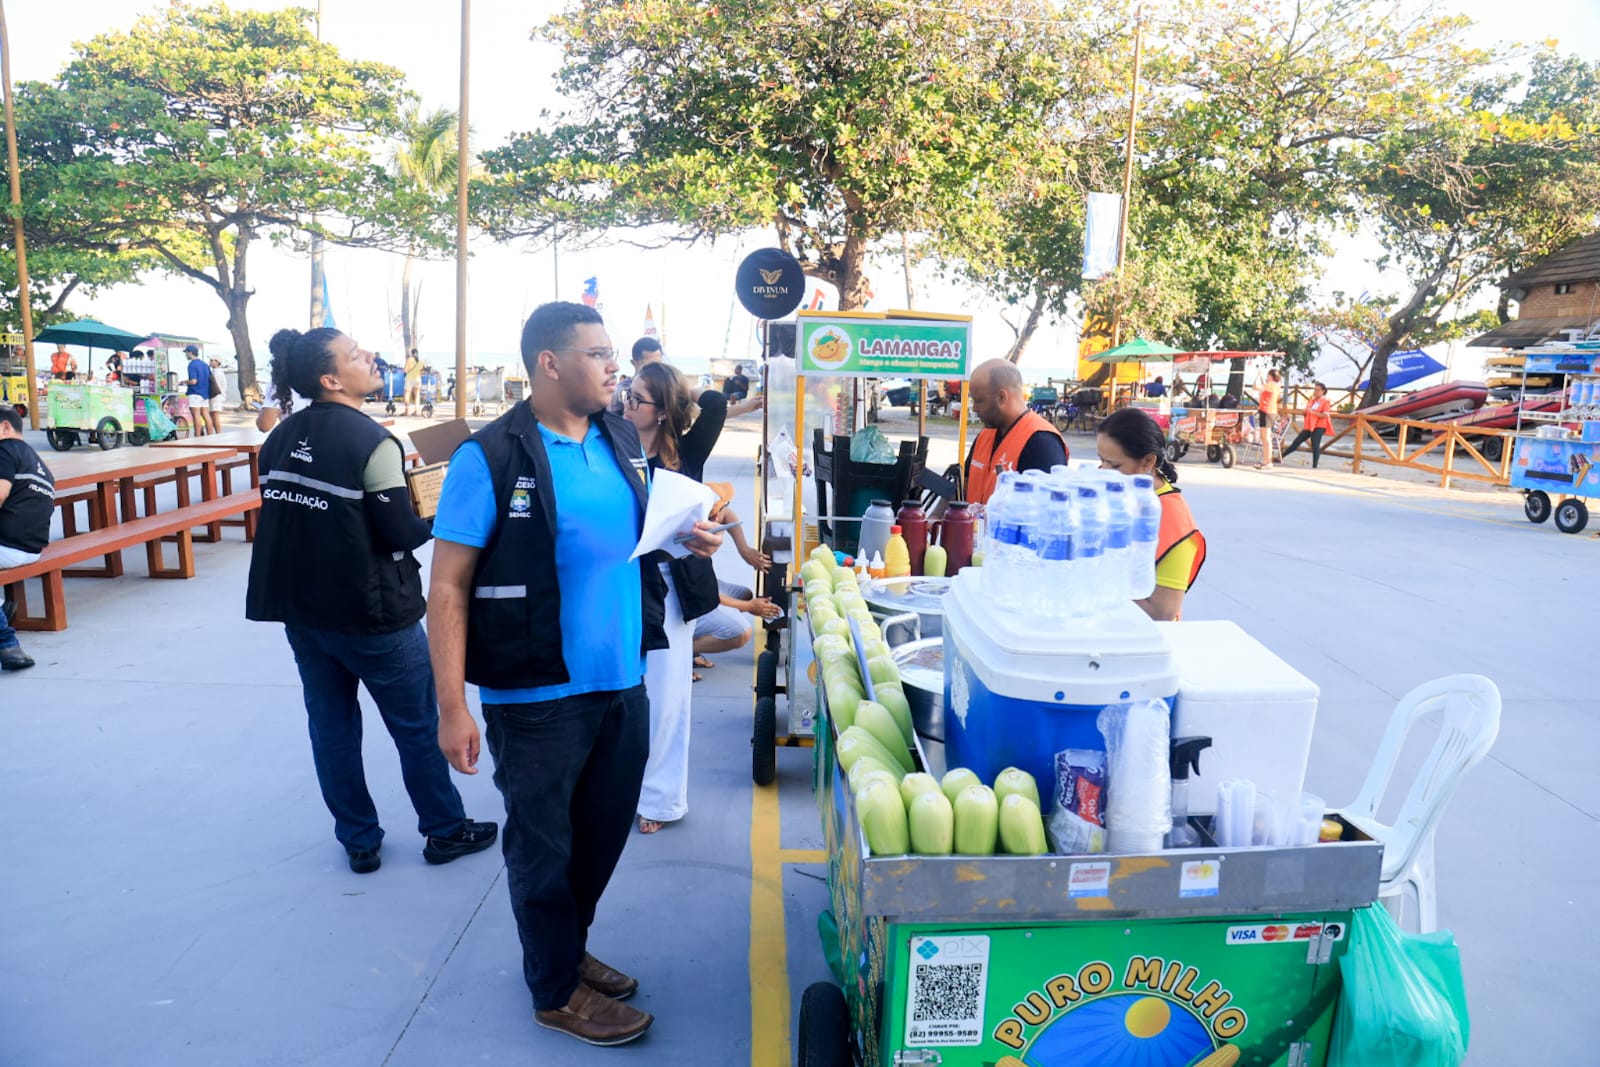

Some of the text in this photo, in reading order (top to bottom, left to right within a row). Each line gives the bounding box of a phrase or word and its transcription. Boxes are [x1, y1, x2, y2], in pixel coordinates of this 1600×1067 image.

[753, 286, 788, 295] DIVINUM
[859, 339, 961, 358] LAMANGA!
[514, 480, 536, 489] CEIÓ
[263, 488, 329, 510] SCALIZAÇÃO
[1231, 929, 1257, 940] VISA
[994, 956, 1248, 1050] PURO MILHO
[909, 1030, 926, 1038] (82)
